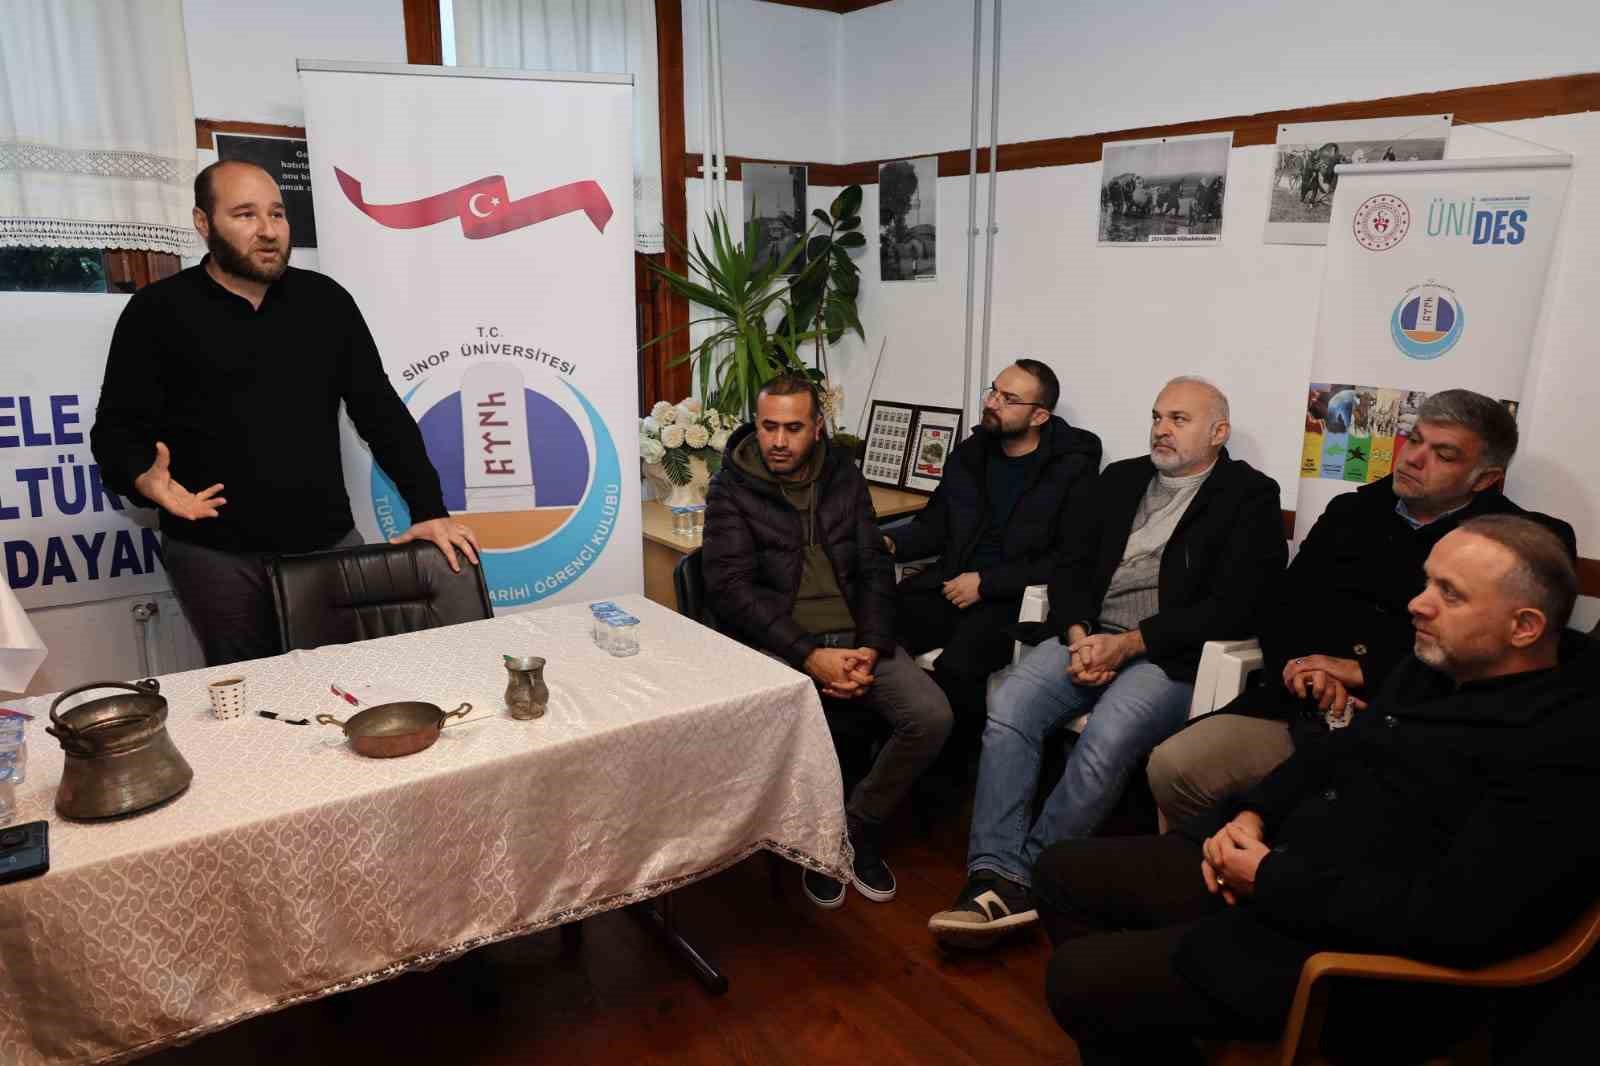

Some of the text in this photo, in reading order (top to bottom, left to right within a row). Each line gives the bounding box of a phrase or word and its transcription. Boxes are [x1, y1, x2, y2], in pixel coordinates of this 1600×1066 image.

[1472, 209, 1528, 245] DES
[476, 326, 504, 338] T.C.
[402, 341, 577, 382] SİNOP ÜNİVERSİTESİ
[0, 394, 84, 449] ELE
